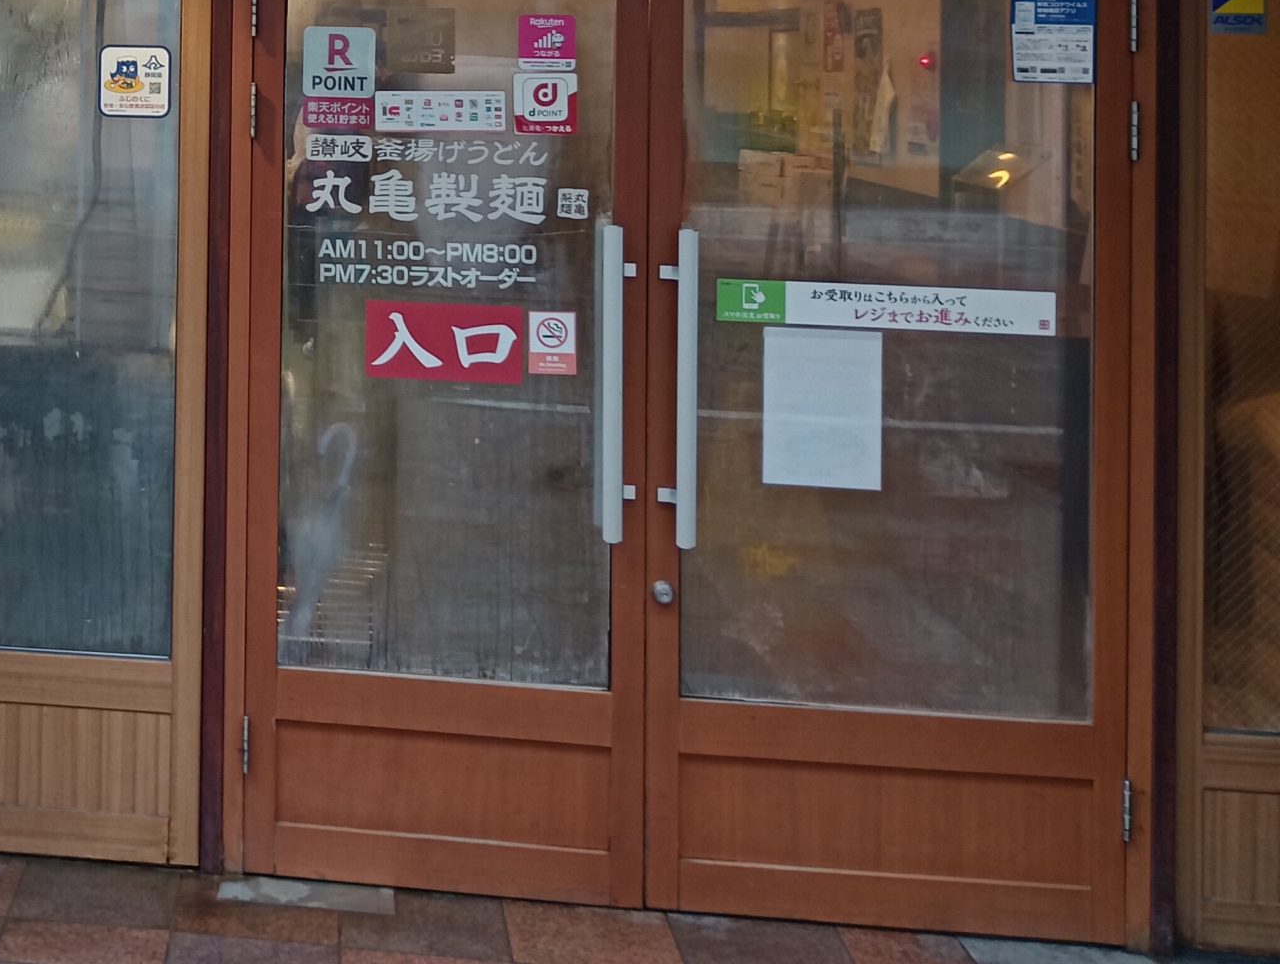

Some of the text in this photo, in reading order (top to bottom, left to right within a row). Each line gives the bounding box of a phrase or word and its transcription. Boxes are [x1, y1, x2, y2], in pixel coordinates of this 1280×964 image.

[529, 17, 564, 26] Rakuten
[1213, 15, 1263, 26] ALSOK
[312, 75, 368, 91] POINT
[308, 102, 370, 114] 楽天ポイント
[537, 109, 563, 117] POINT
[311, 137, 548, 166] 讃岐 釜揚げうどん
[306, 169, 547, 225] 丸亀製麺
[320, 264, 536, 290] PM7:30ラストオーダー
[810, 288, 967, 307] お受取りはこちらから入って
[854, 308, 1014, 328] レジまでお進みください
[370, 312, 517, 369] 入口
